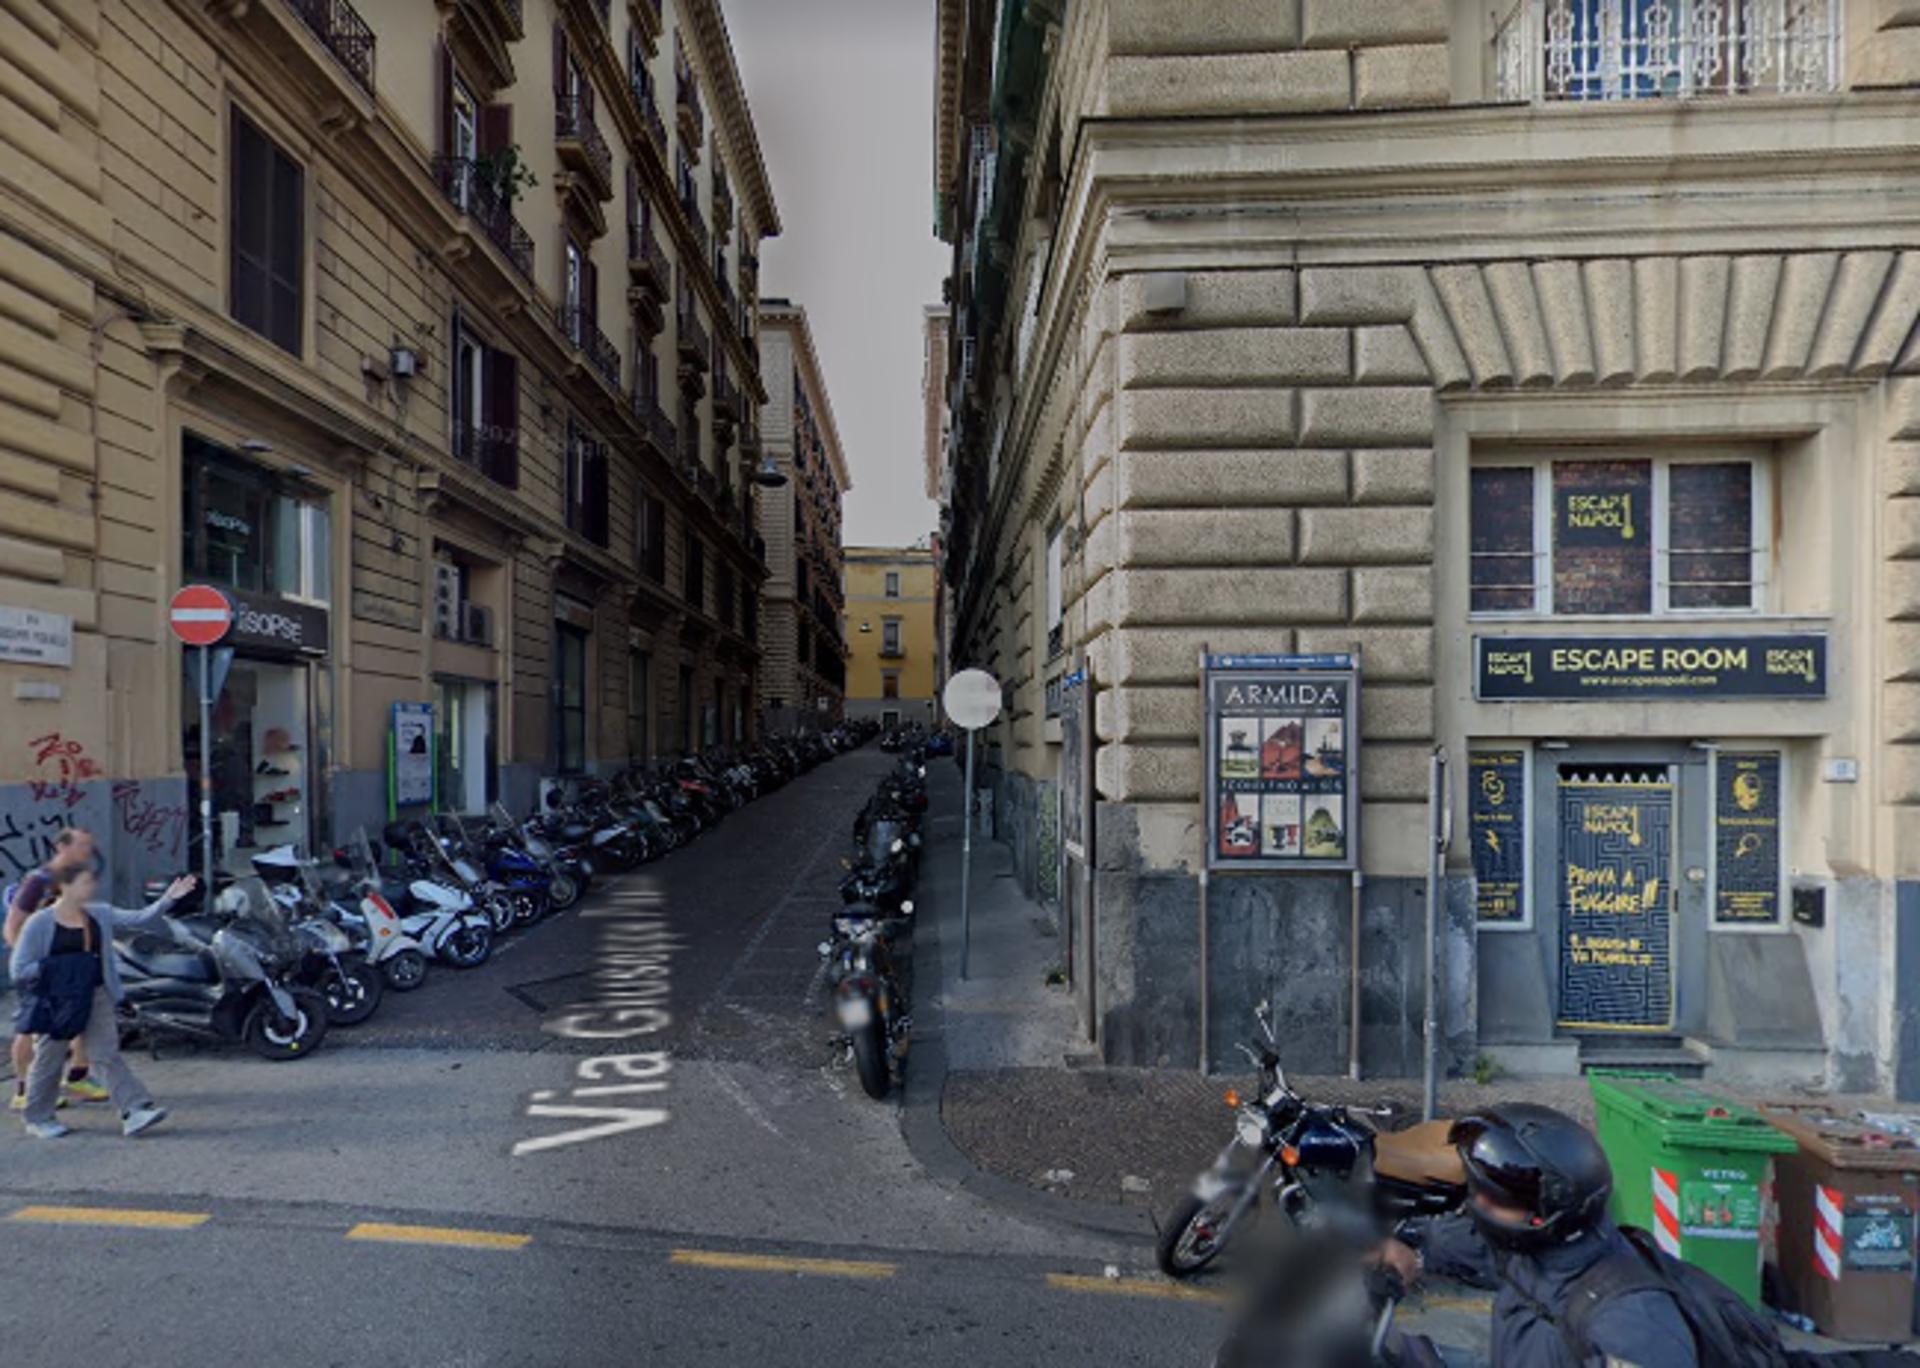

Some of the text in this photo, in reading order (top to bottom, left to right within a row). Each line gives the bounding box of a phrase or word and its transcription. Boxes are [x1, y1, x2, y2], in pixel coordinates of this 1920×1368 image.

[1552, 648, 1748, 671] ESCAPE ROOM
[1225, 684, 1340, 704] ARMIDA
